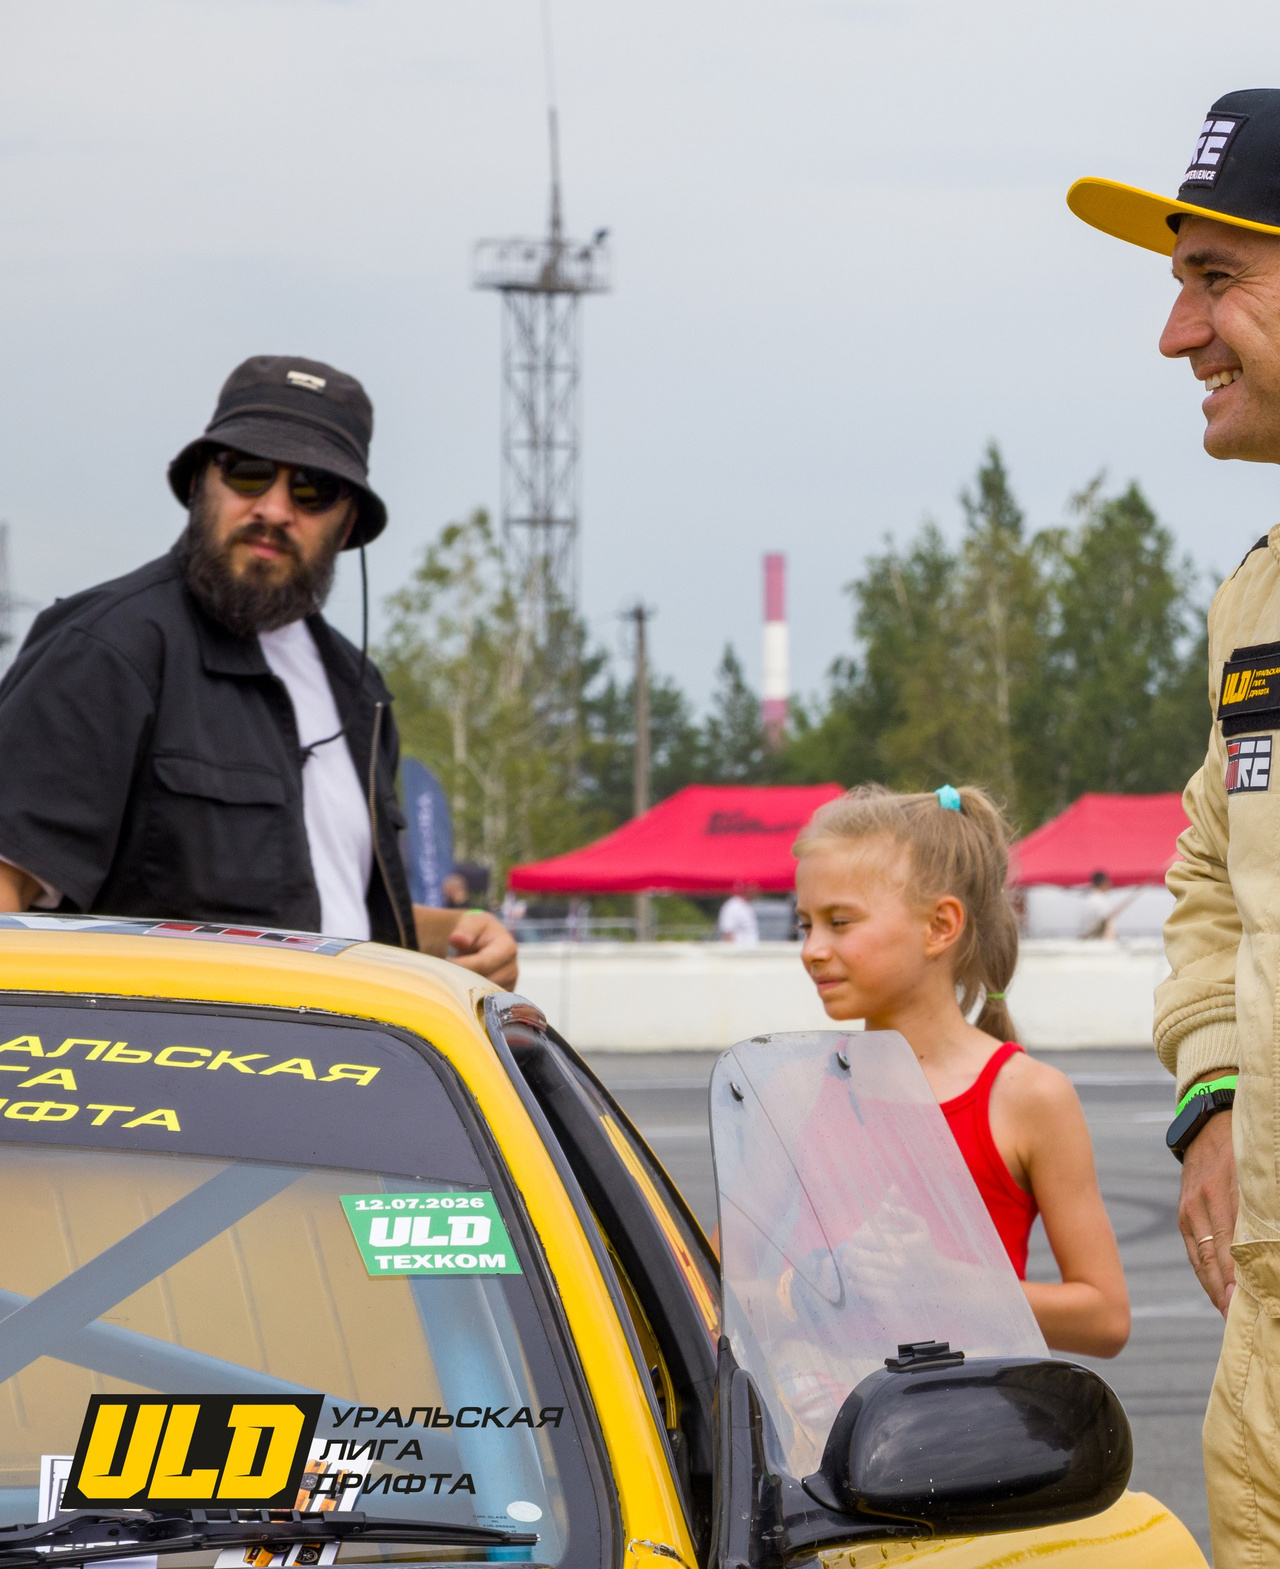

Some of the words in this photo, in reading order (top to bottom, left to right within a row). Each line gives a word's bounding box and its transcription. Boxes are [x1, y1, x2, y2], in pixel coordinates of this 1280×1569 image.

[1222, 669, 1252, 706] ULD
[0, 1035, 381, 1086] АЛЬСКАЯ
[355, 1197, 485, 1211] 12.07.2026
[368, 1215, 492, 1248] ULD
[374, 1253, 506, 1270] ТЕХКОМ
